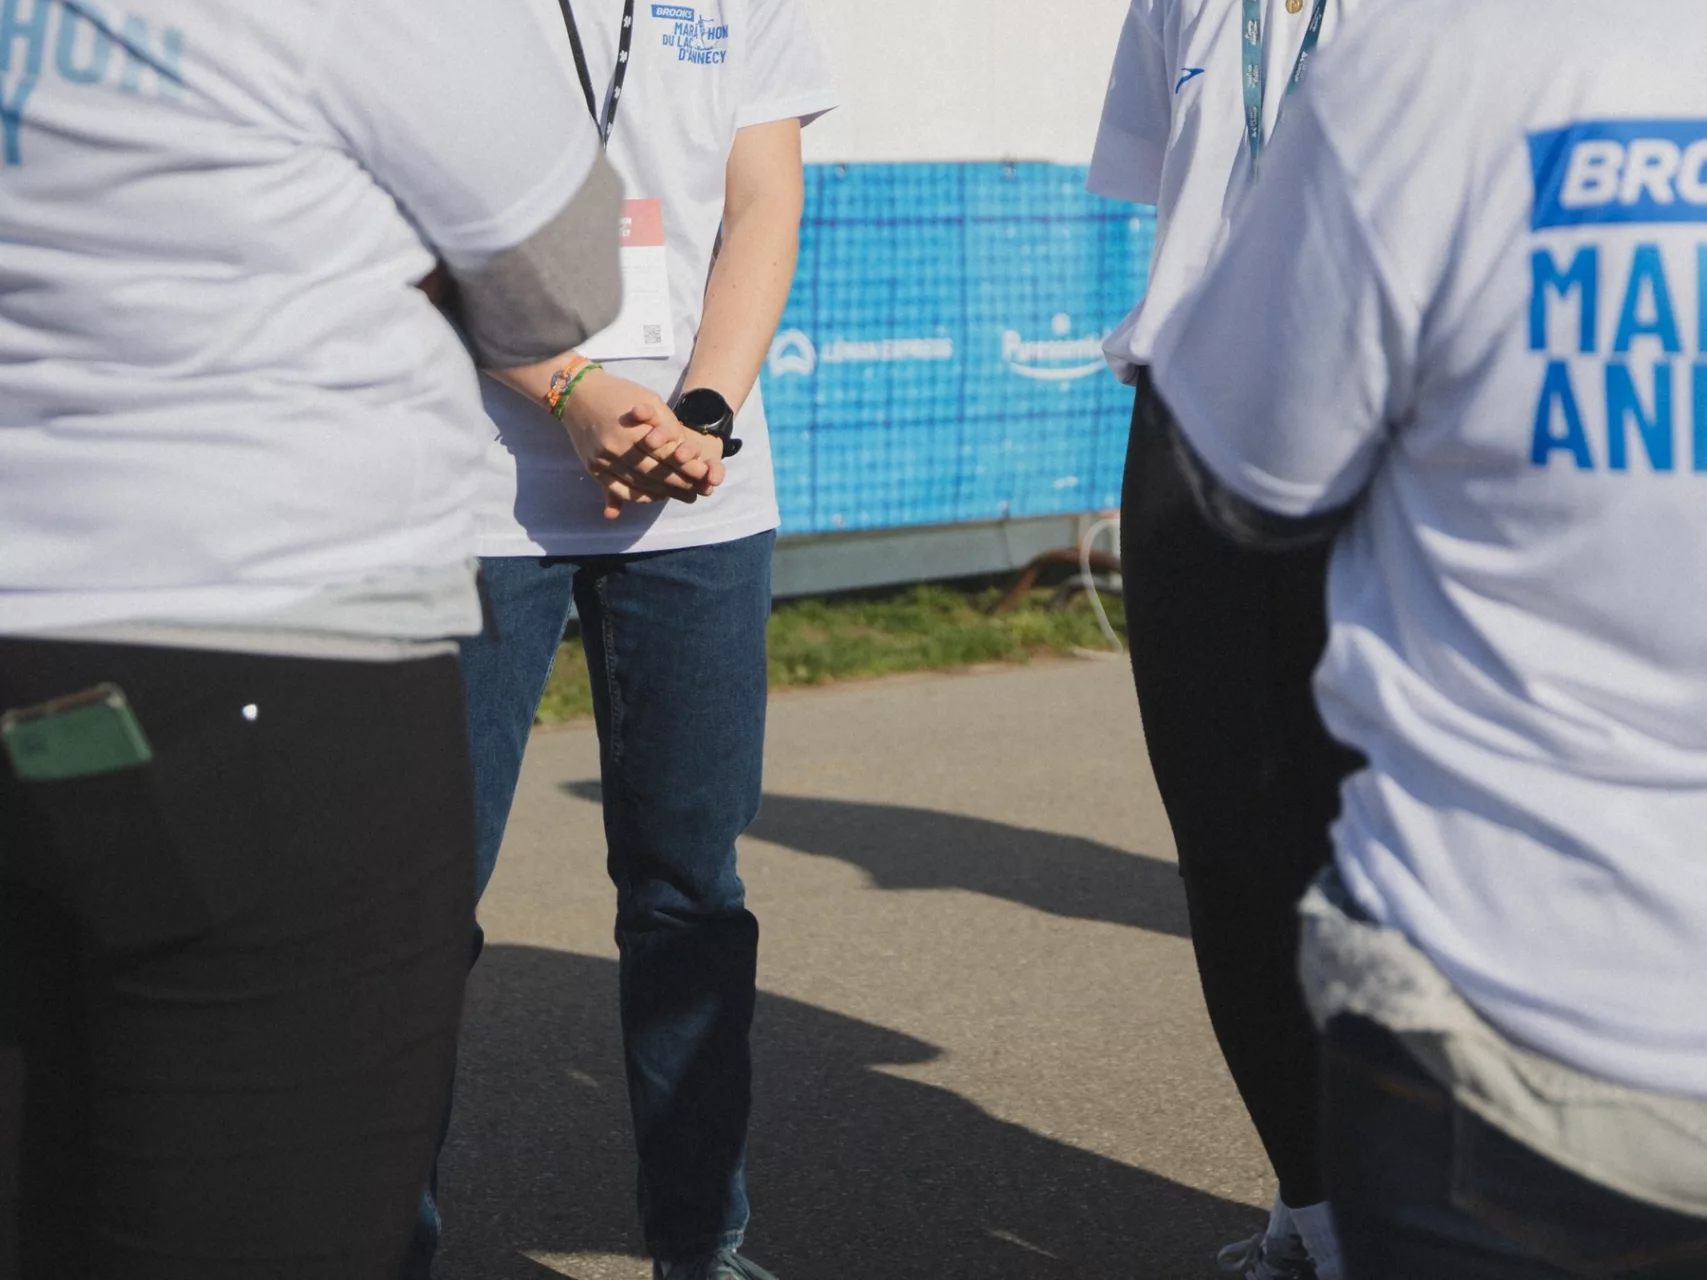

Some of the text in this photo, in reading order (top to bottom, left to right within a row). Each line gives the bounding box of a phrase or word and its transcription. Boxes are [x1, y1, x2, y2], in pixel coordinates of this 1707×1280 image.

[655, 7, 693, 19] BROOKS
[662, 33, 694, 48] DU LAC
[678, 47, 727, 65] D'ANNECY
[1527, 242, 1707, 355] MA
[1530, 357, 1707, 474] AN
